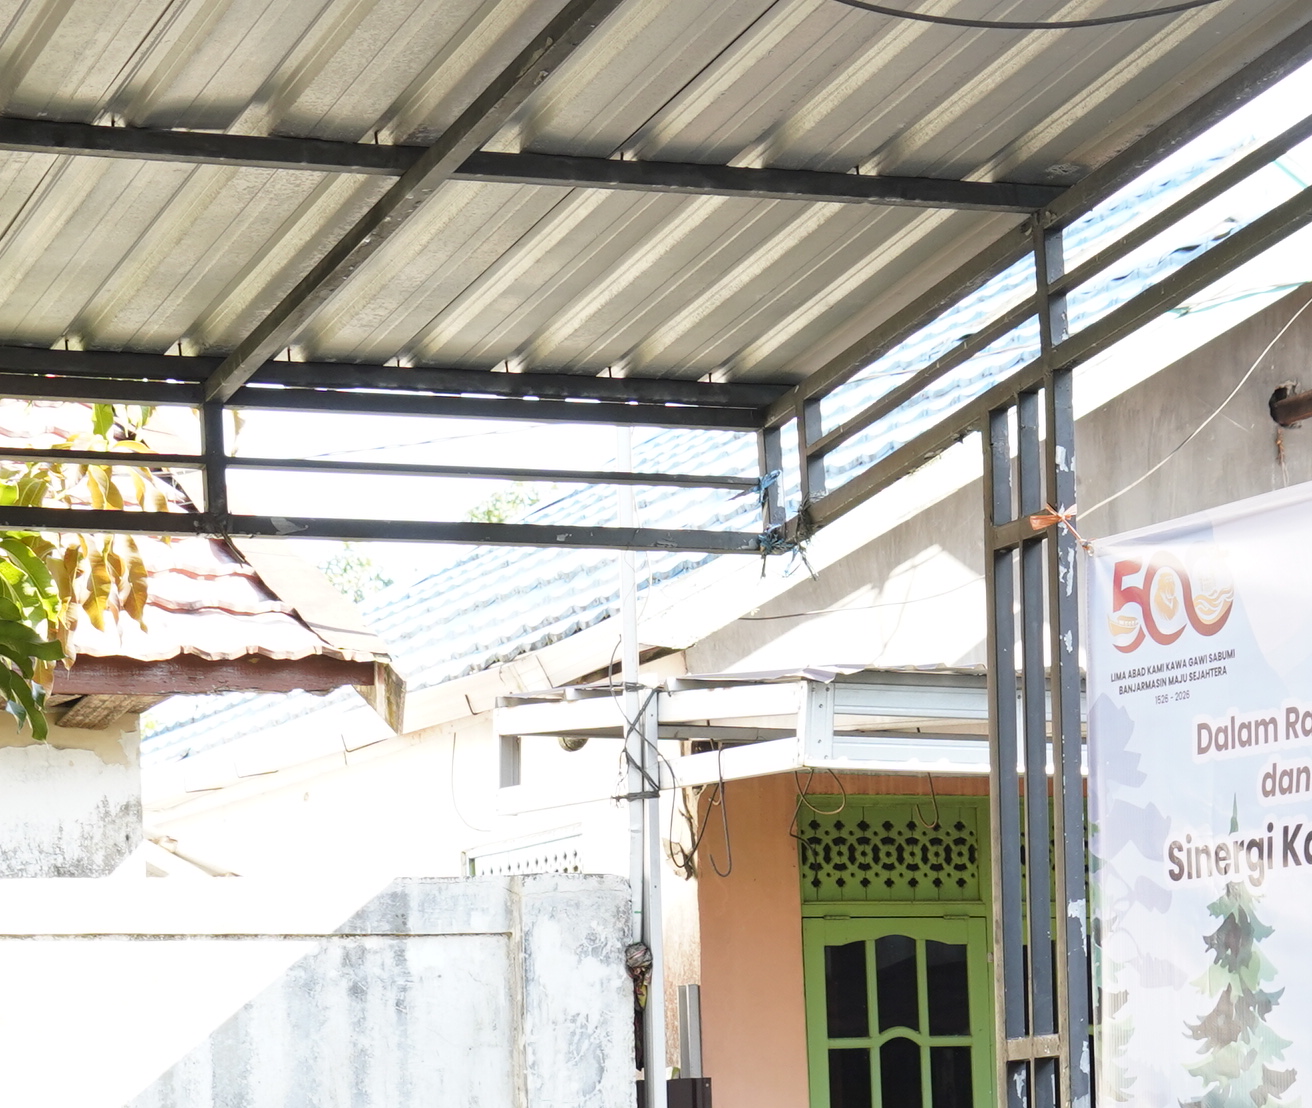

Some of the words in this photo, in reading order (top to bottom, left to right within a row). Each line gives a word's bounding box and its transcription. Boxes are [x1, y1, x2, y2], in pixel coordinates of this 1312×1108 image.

[1110, 671, 1126, 683] LIMA
[1128, 667, 1146, 679] ABAD
[1147, 663, 1164, 676] KAMI
[1166, 659, 1187, 672] KAWA
[1188, 654, 1207, 667] GAWI
[1209, 649, 1235, 664] SABUMI
[1119, 679, 1167, 695] BANJARMASIN
[1168, 673, 1187, 685] MAJU
[1189, 666, 1227, 681] SEJAHTERA
[1197, 716, 1278, 755] Dalam
[1262, 764, 1311, 798] dan
[1168, 821, 1274, 887] Sinergi
